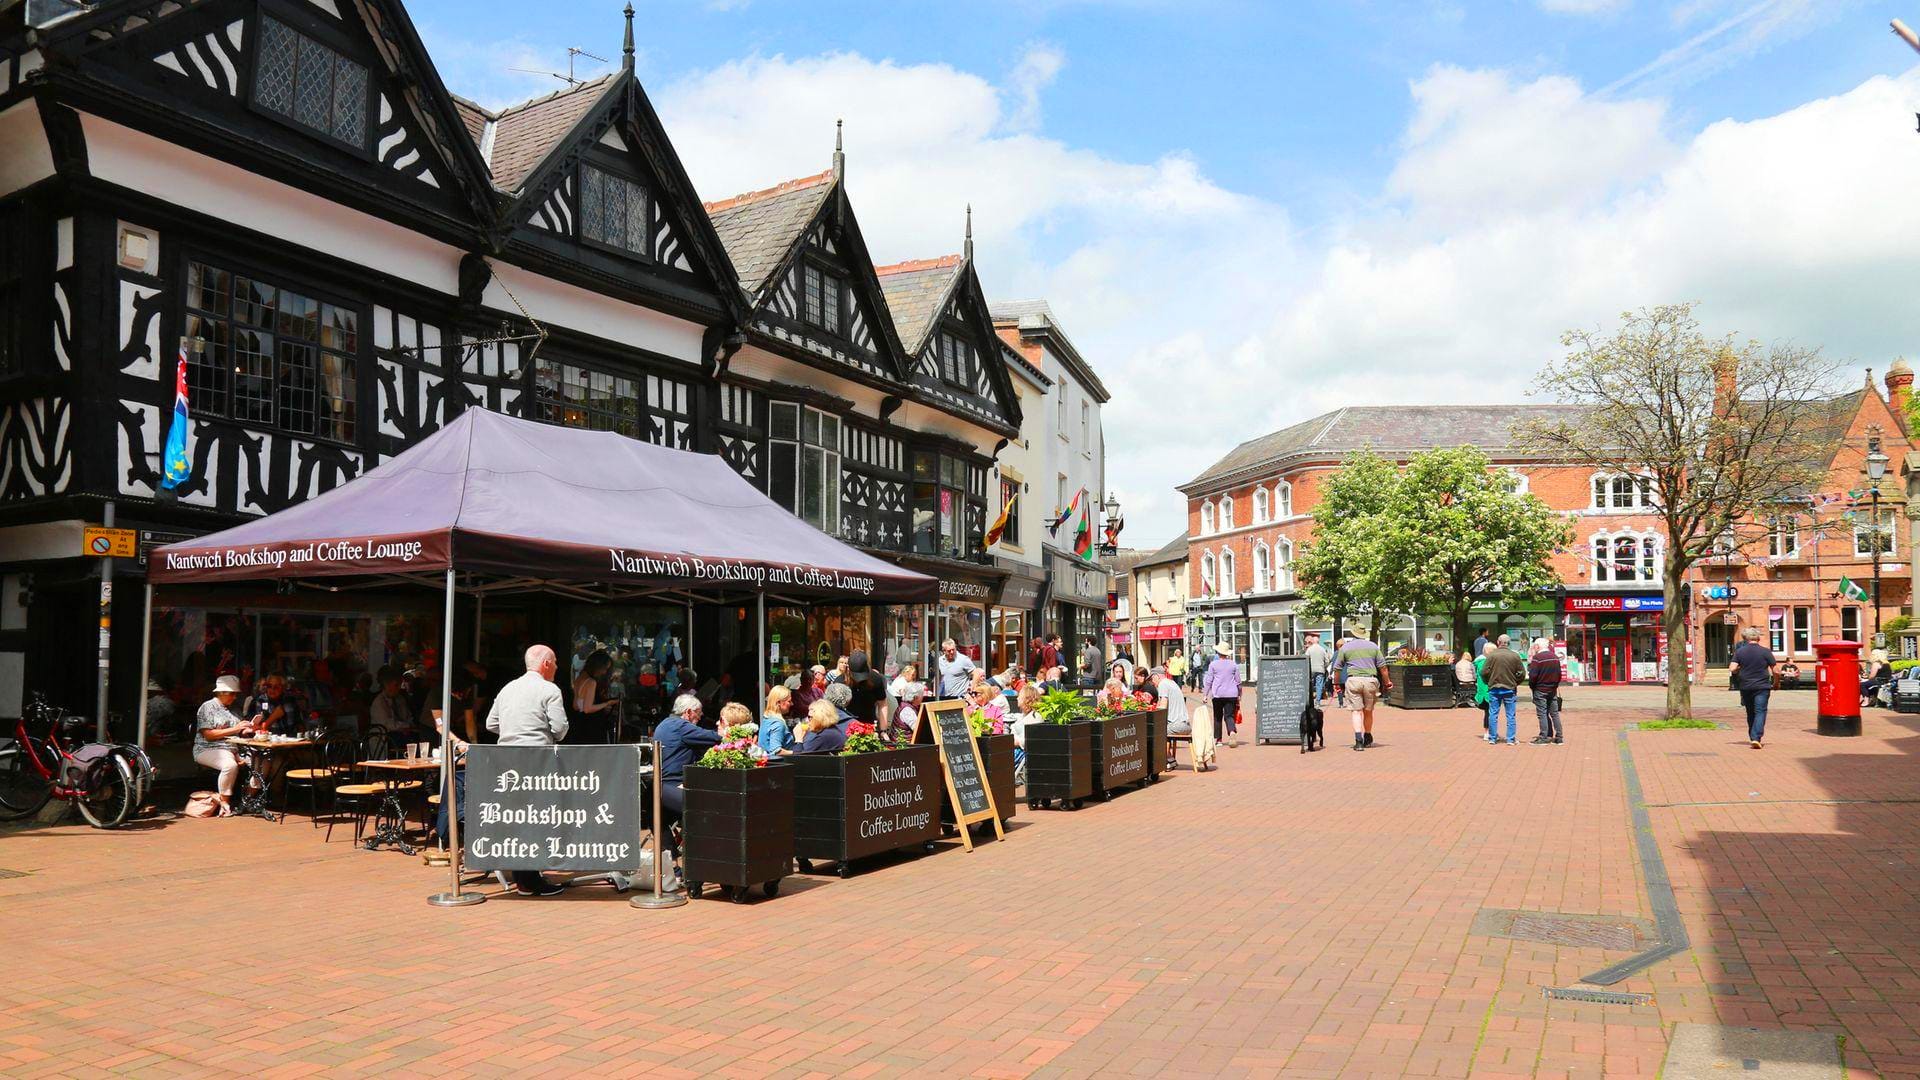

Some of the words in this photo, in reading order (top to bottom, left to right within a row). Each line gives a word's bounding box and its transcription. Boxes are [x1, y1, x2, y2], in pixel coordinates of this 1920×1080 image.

[166, 551, 222, 570] Nantwich
[225, 547, 287, 569] Bookshop
[289, 543, 314, 563] and
[316, 541, 363, 562] Coffee
[367, 540, 422, 561] Lounge
[608, 548, 690, 578] Nantwich
[693, 558, 766, 587] Bookshop
[769, 564, 791, 584] and
[794, 566, 834, 588] Coffee
[835, 570, 875, 596] Lounge
[938, 580, 949, 593] ER
[949, 581, 981, 596] RESEARCH
[980, 585, 990, 598] UK
[1711, 586, 1738, 598] TSB
[1572, 598, 1616, 607] TIMPSON
[1113, 723, 1137, 740] Nantwich
[1111, 742, 1135, 758] Bookshop
[1134, 740, 1140, 752] &
[870, 760, 916, 784] Nantwich
[1109, 761, 1126, 777] Coffee
[1125, 759, 1142, 771] Lounge
[493, 768, 600, 795] Nantwich
[863, 788, 912, 812] Bookshop
[914, 784, 924, 802] &
[479, 802, 587, 828] Bookshop
[594, 802, 615, 825] &
[860, 816, 893, 838] Coffee
[895, 811, 930, 830] Lounge
[471, 836, 540, 858] Coffee
[545, 836, 630, 862] Lounge
